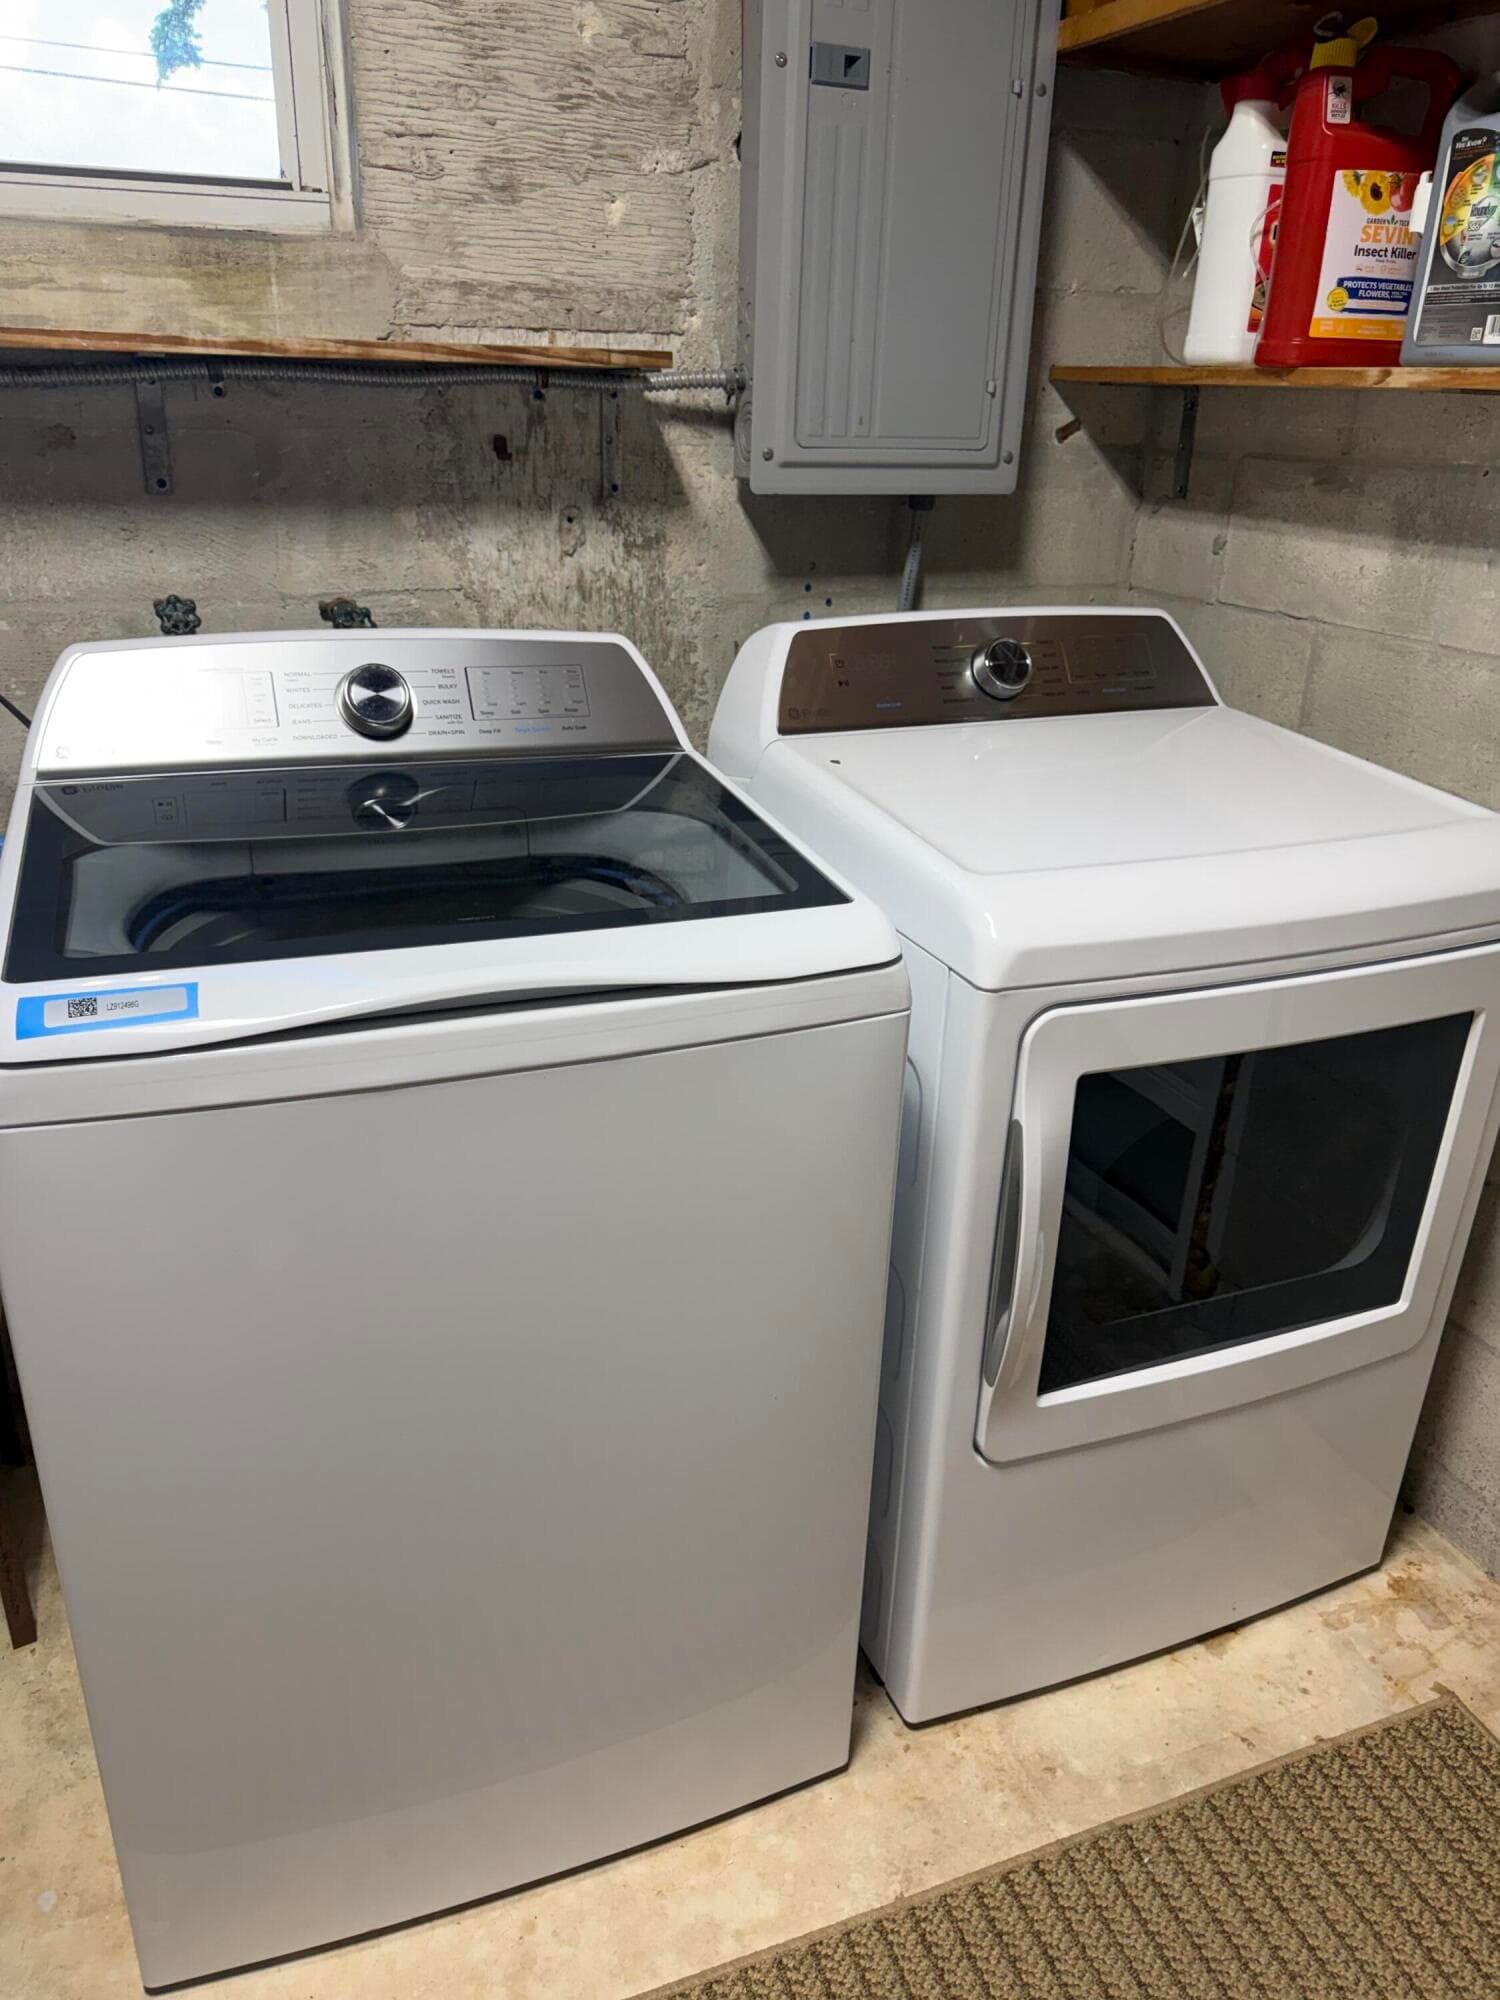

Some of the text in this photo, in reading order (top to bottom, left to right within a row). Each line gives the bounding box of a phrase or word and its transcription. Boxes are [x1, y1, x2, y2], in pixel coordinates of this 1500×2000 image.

[1360, 224, 1414, 246] SEVIN
[1354, 244, 1389, 258] Insect
[1390, 246, 1417, 261] Killer
[1343, 280, 1378, 290] PROTECTS
[288, 702, 323, 710] DELICATES
